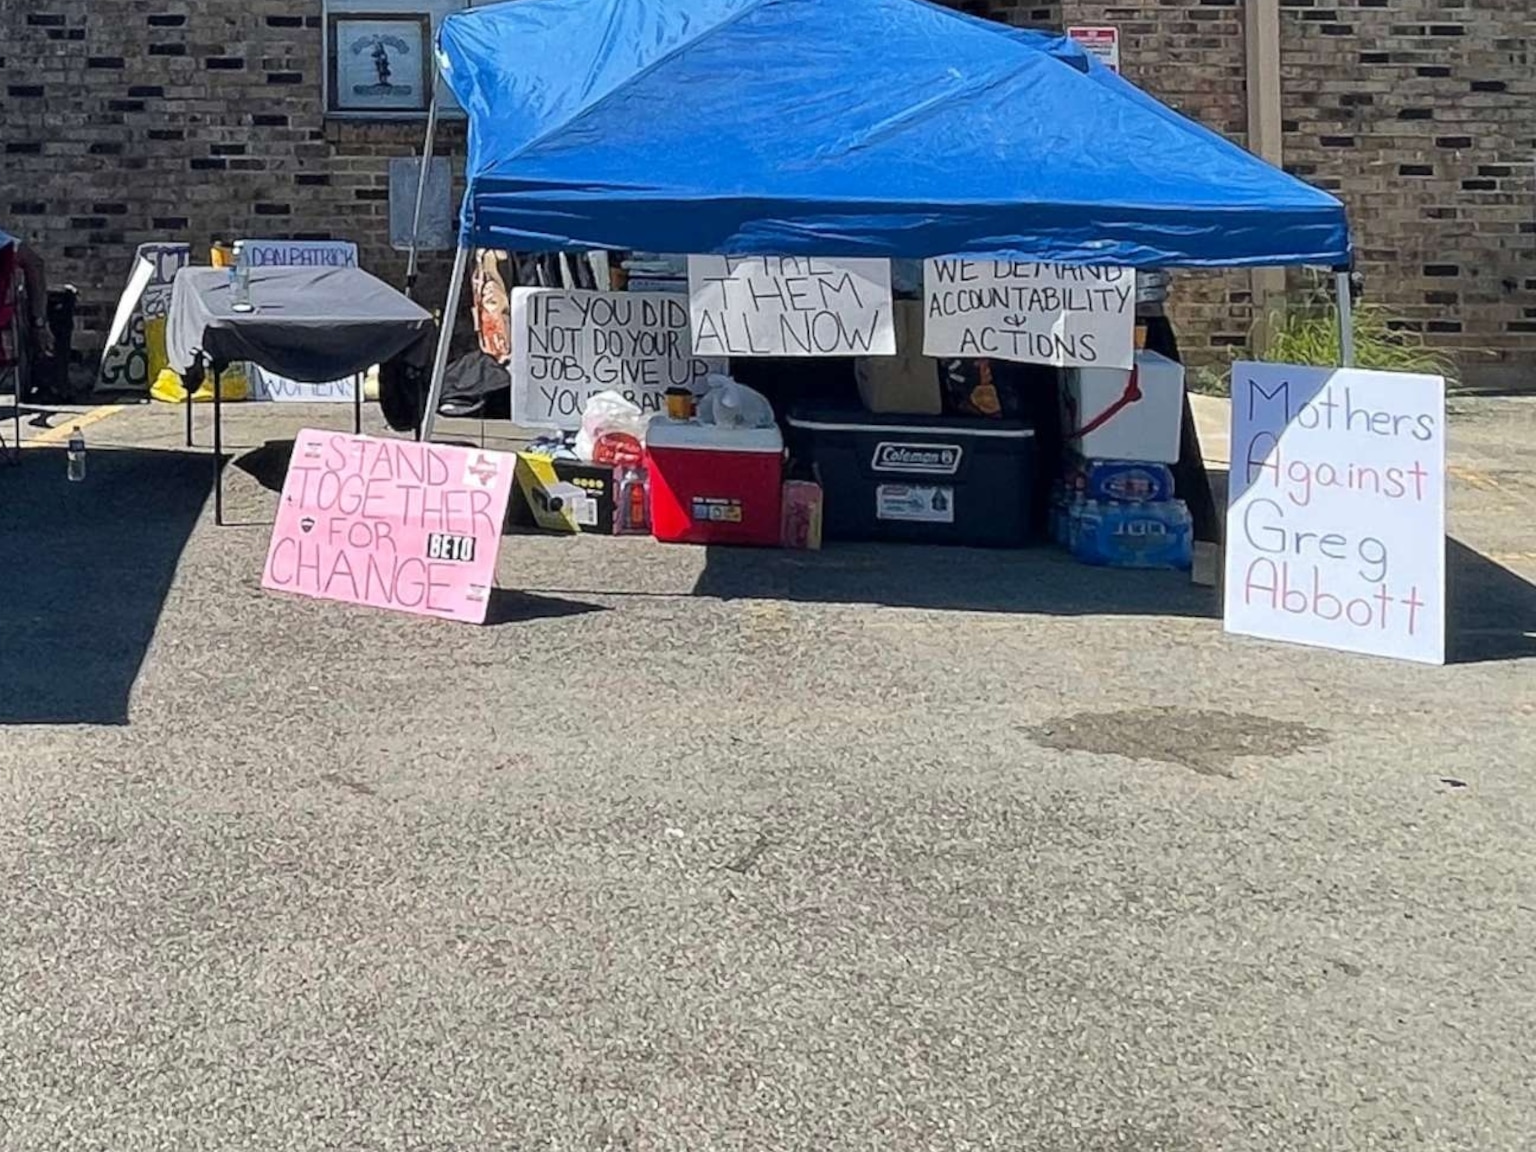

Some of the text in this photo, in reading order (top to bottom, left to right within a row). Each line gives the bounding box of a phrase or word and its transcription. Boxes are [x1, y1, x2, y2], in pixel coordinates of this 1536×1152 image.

[933, 259, 1124, 283] WE DEMAND
[703, 272, 864, 312] THEM
[928, 285, 1132, 319] ACCOUNTABILITY
[534, 296, 688, 329] IF YOU DID
[695, 309, 879, 353] ALL NOW
[528, 325, 682, 360] NOT DO YOUR
[959, 327, 1098, 362] ACTIONS
[530, 354, 710, 386] JOB, GIVE UP
[1247, 378, 1435, 441] Mothers
[325, 435, 449, 487] STAND
[882, 446, 939, 463] Coleman
[1245, 430, 1429, 507] Against
[292, 466, 496, 537] TOGETHER
[328, 517, 397, 552] FOR
[429, 534, 474, 561] BETO
[1243, 497, 1388, 583] Greg
[270, 536, 458, 613] CHANGE
[1245, 556, 1425, 635] Abbott
